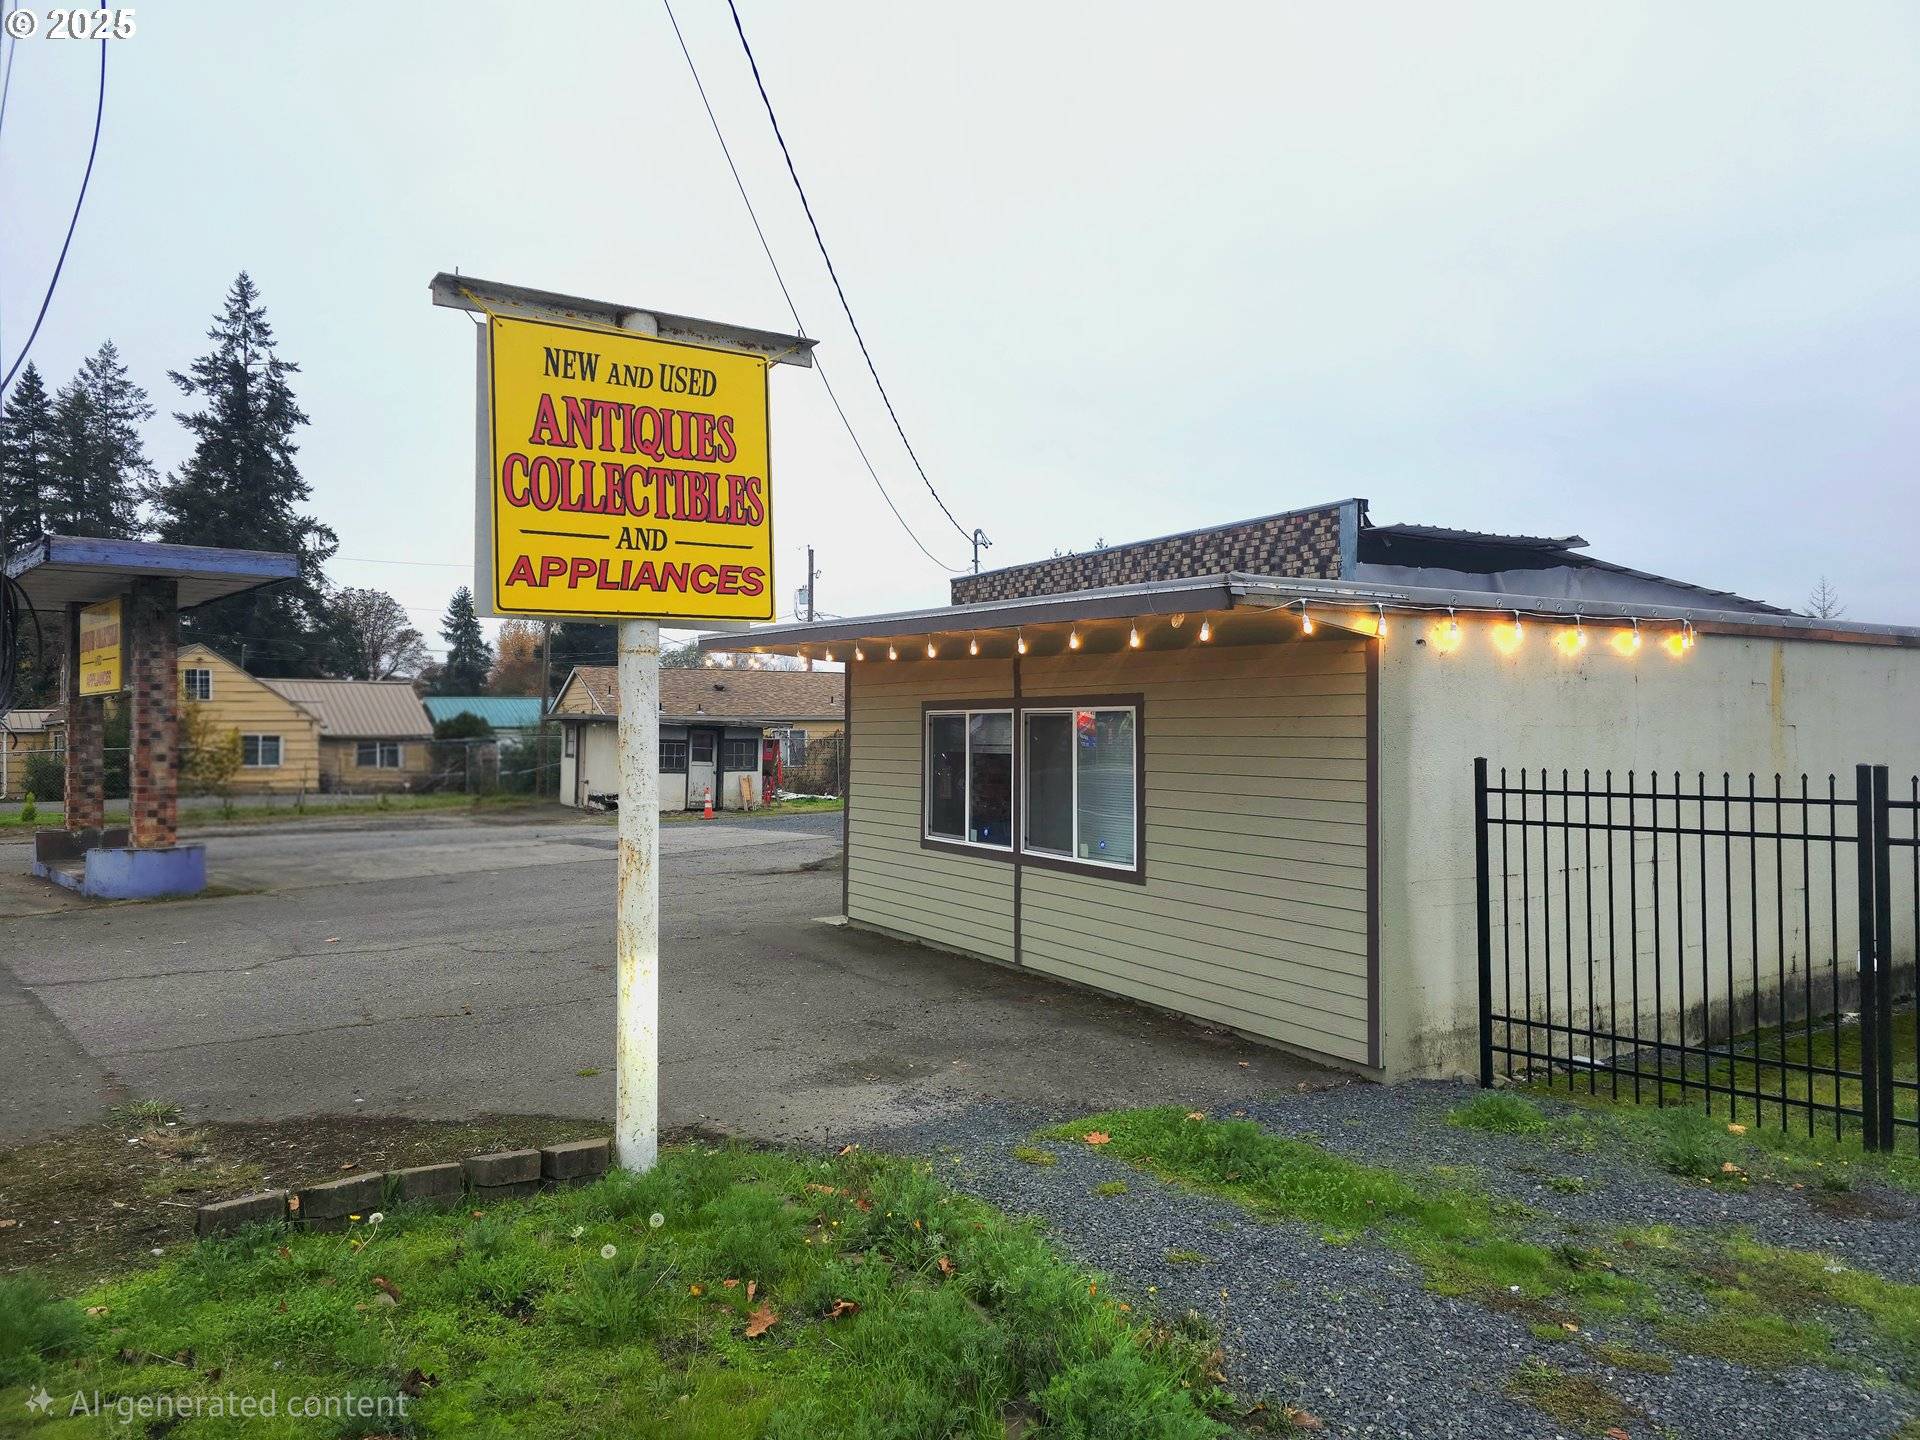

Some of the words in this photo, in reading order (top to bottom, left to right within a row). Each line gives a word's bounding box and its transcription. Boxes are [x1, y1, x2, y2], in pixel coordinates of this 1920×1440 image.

[544, 347, 600, 381] NEW
[606, 363, 654, 389] AND
[658, 363, 717, 397] USED
[529, 393, 737, 463] ANTIQUES
[502, 453, 764, 526] COLLECTIBLES
[615, 526, 668, 552] AND
[505, 555, 765, 596] APPLIANCES
